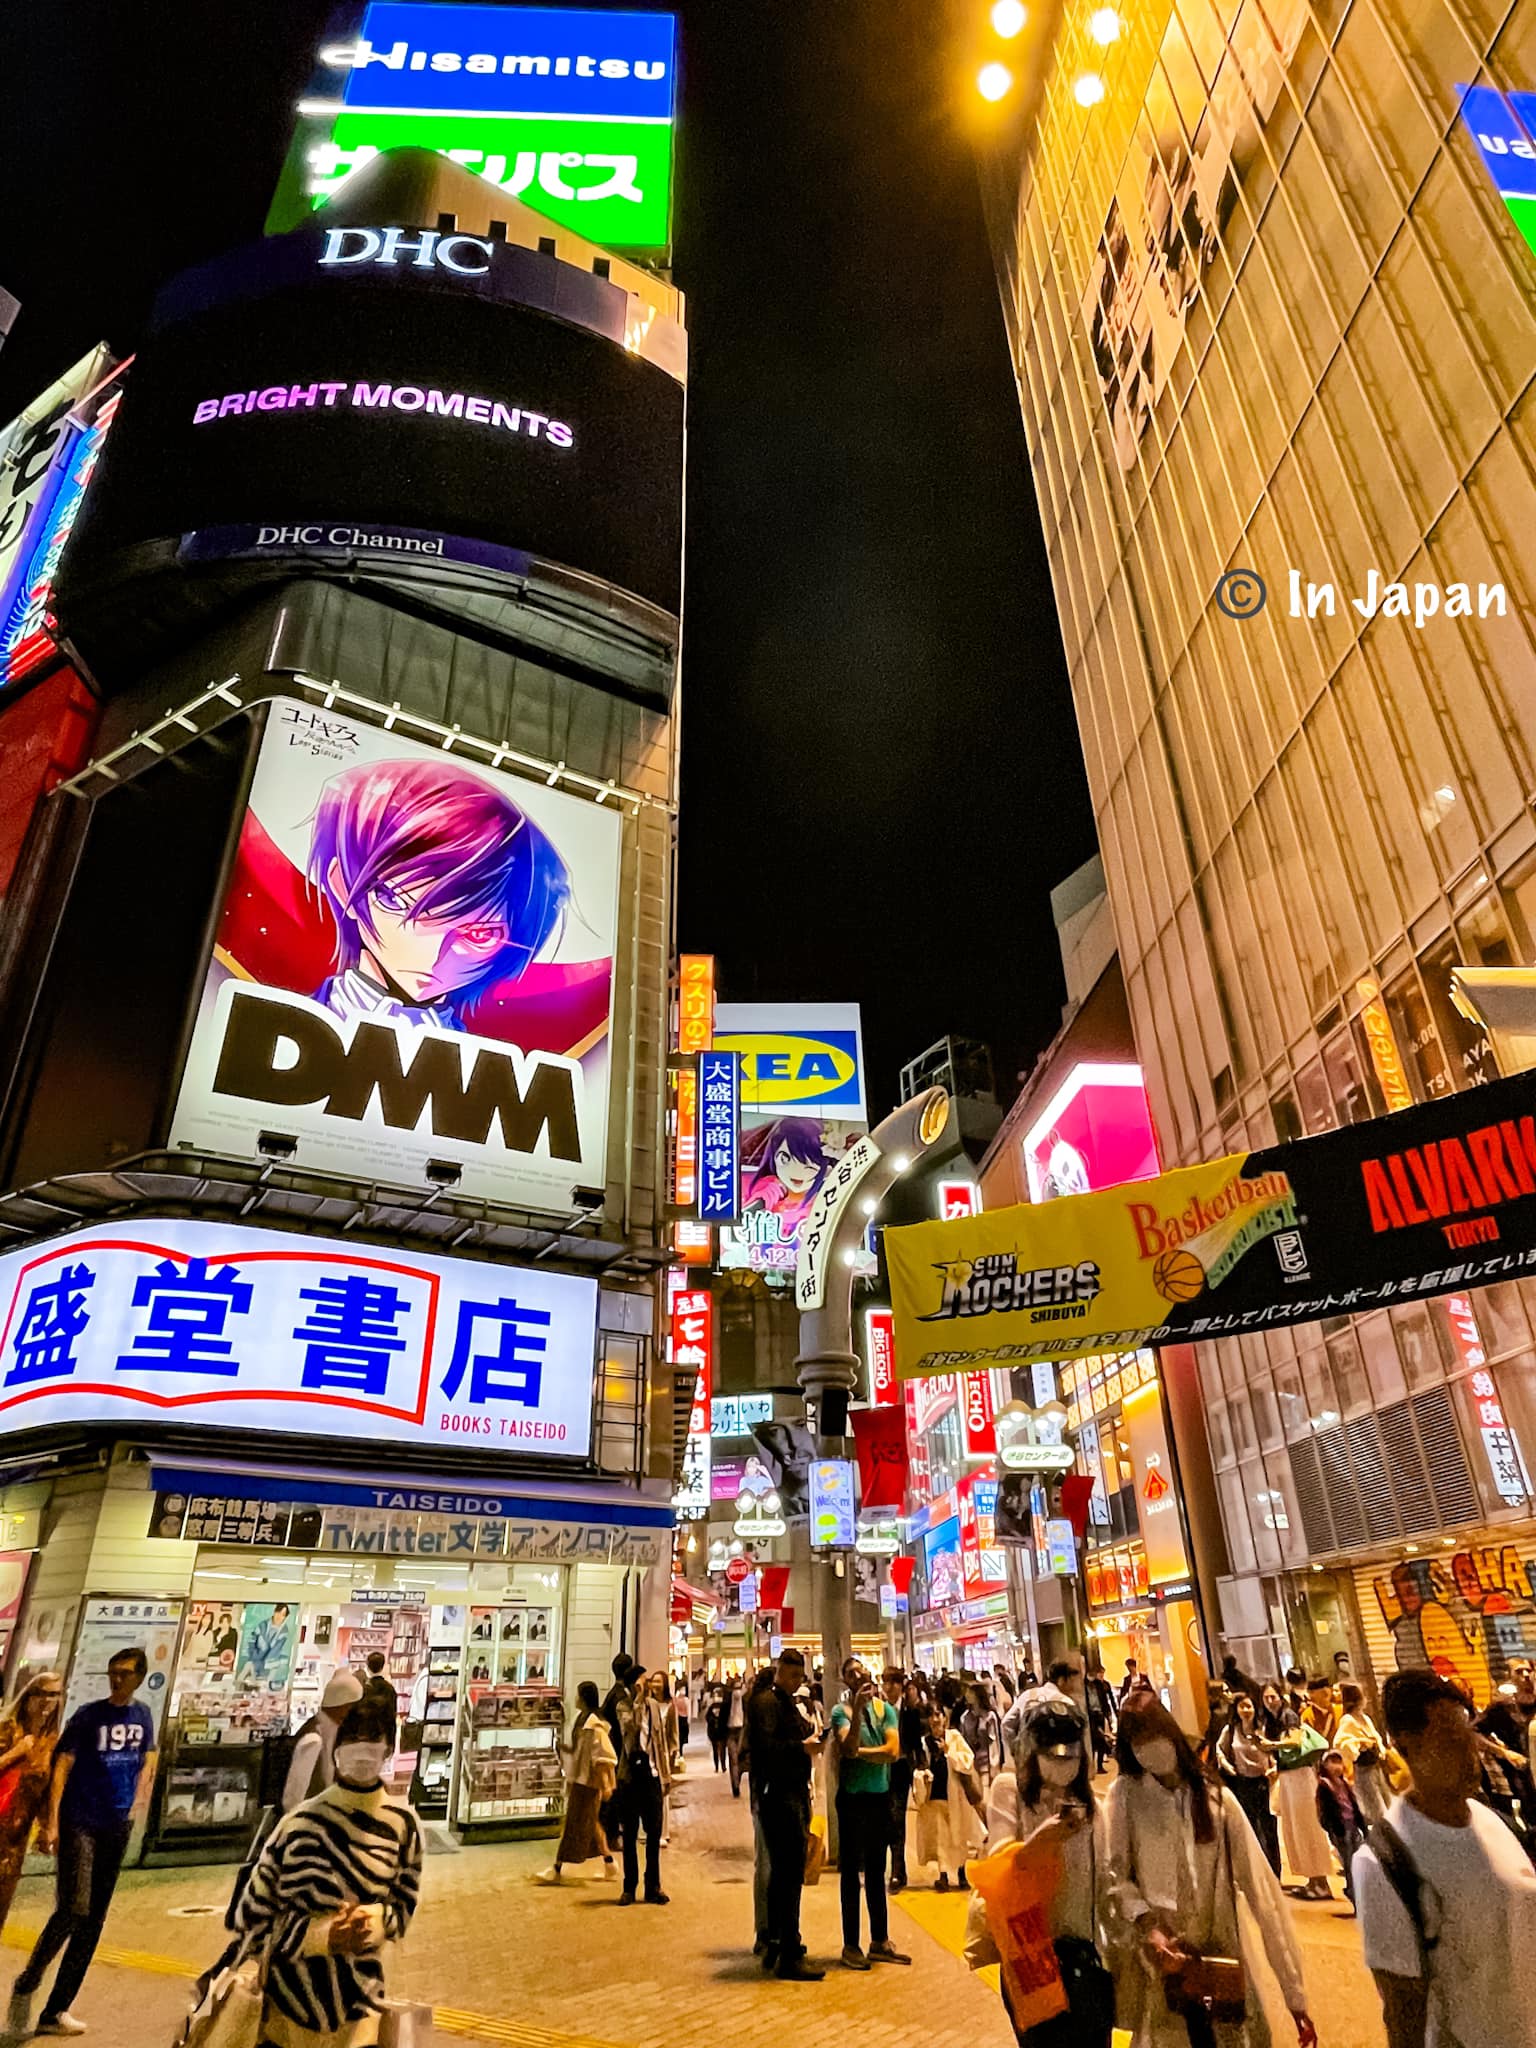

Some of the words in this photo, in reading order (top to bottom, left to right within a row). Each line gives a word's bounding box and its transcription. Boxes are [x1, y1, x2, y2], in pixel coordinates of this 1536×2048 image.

[319, 41, 666, 80] Hisamitsu
[318, 227, 494, 275] DHC
[193, 384, 346, 424] BRIGHT
[351, 384, 574, 448] MOMENTS
[256, 526, 323, 547] DHC
[328, 528, 444, 556] Channel
[211, 991, 582, 1163] DMM
[704, 1061, 733, 1212] 大盛堂商事ビル
[800, 1144, 868, 1303] 渋谷センター街
[1127, 1172, 1289, 1260] Basketball
[1442, 1216, 1500, 1249] TOKYO
[974, 1252, 1016, 1278] SUN
[915, 1260, 1104, 1322] ROCKERS
[3, 1258, 550, 1407] 盛堂書店
[1030, 1305, 1086, 1324] SHIBUYA
[872, 1328, 885, 1352] BIG
[875, 1354, 889, 1389] ECHO
[968, 1381, 986, 1432] ECHO
[440, 1414, 492, 1434] BOOKS
[500, 1417, 567, 1441] TAISEIDO
[711, 1420, 754, 1434] クリニ
[371, 1490, 503, 1514] TAISEIDO
